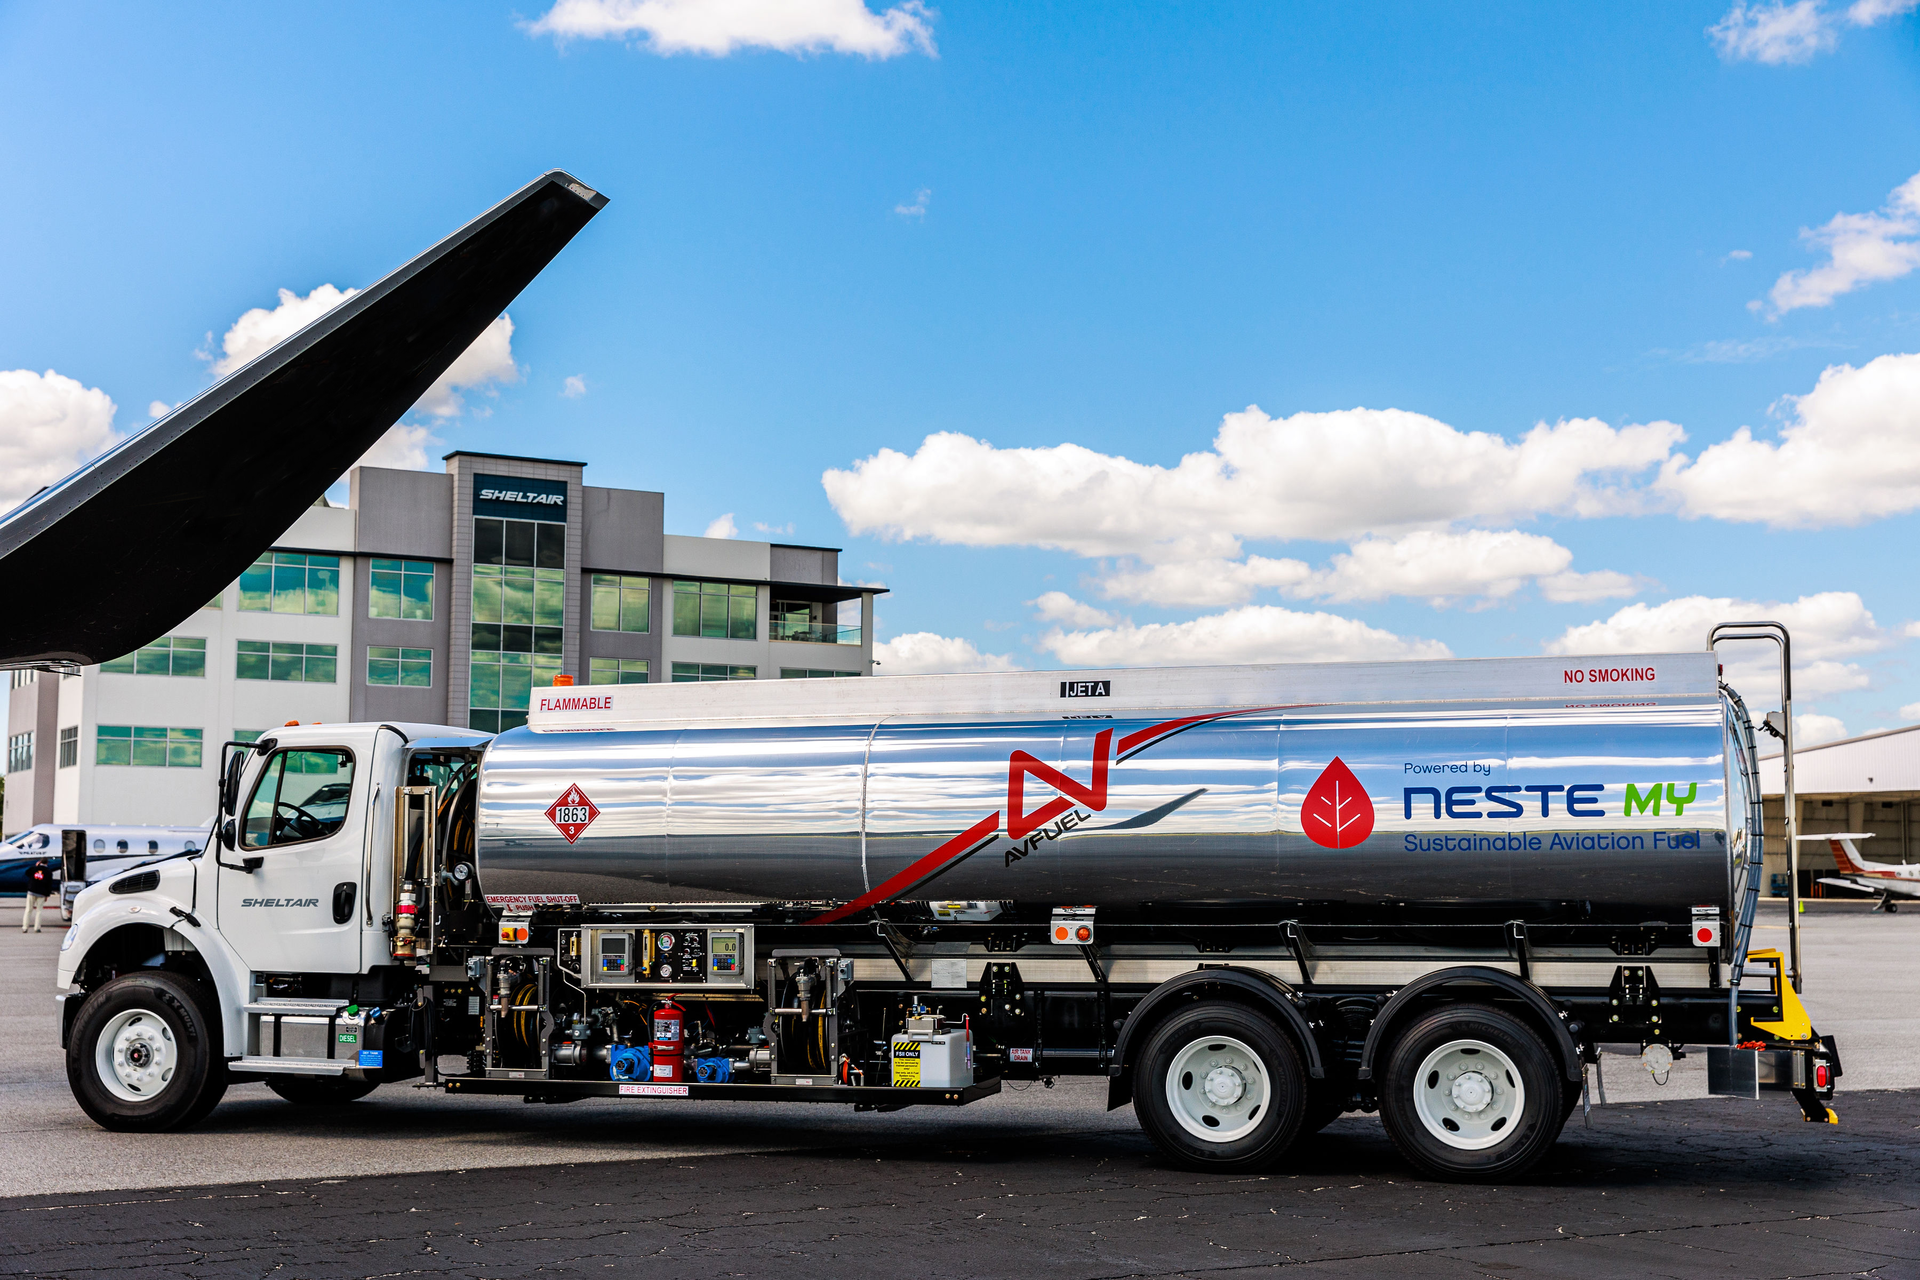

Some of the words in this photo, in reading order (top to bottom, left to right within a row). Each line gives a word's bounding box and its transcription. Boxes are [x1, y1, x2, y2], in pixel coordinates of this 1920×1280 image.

[479, 489, 564, 505] SHELTAIR
[1564, 669, 1584, 684] NO
[1589, 667, 1655, 683] SMOKING
[1070, 682, 1095, 696] JET
[1095, 682, 1105, 696] A
[540, 696, 612, 711] FLAMMABLE
[1404, 761, 1468, 774] Powered
[1473, 761, 1491, 776] by
[1624, 782, 1698, 817] MY
[557, 807, 587, 823] 1863
[569, 826, 575, 835] 3
[1004, 809, 1092, 868] AVFUEL
[1404, 832, 1542, 852] Sustainable
[1550, 832, 1644, 851] Aviation
[1653, 830, 1700, 850] Fuel
[241, 898, 319, 907] SHELTAIR
[486, 895, 527, 903] EMERGENCY
[527, 895, 546, 903] FUEL
[546, 895, 578, 903] SHUT-OFF
[725, 943, 736, 952] 0.0
[178, 1008, 197, 1037] MULTI
[339, 1034, 356, 1043] DIESEL
[620, 1085, 635, 1094] FIRE
[637, 1086, 688, 1095] EXTINGUISHER
